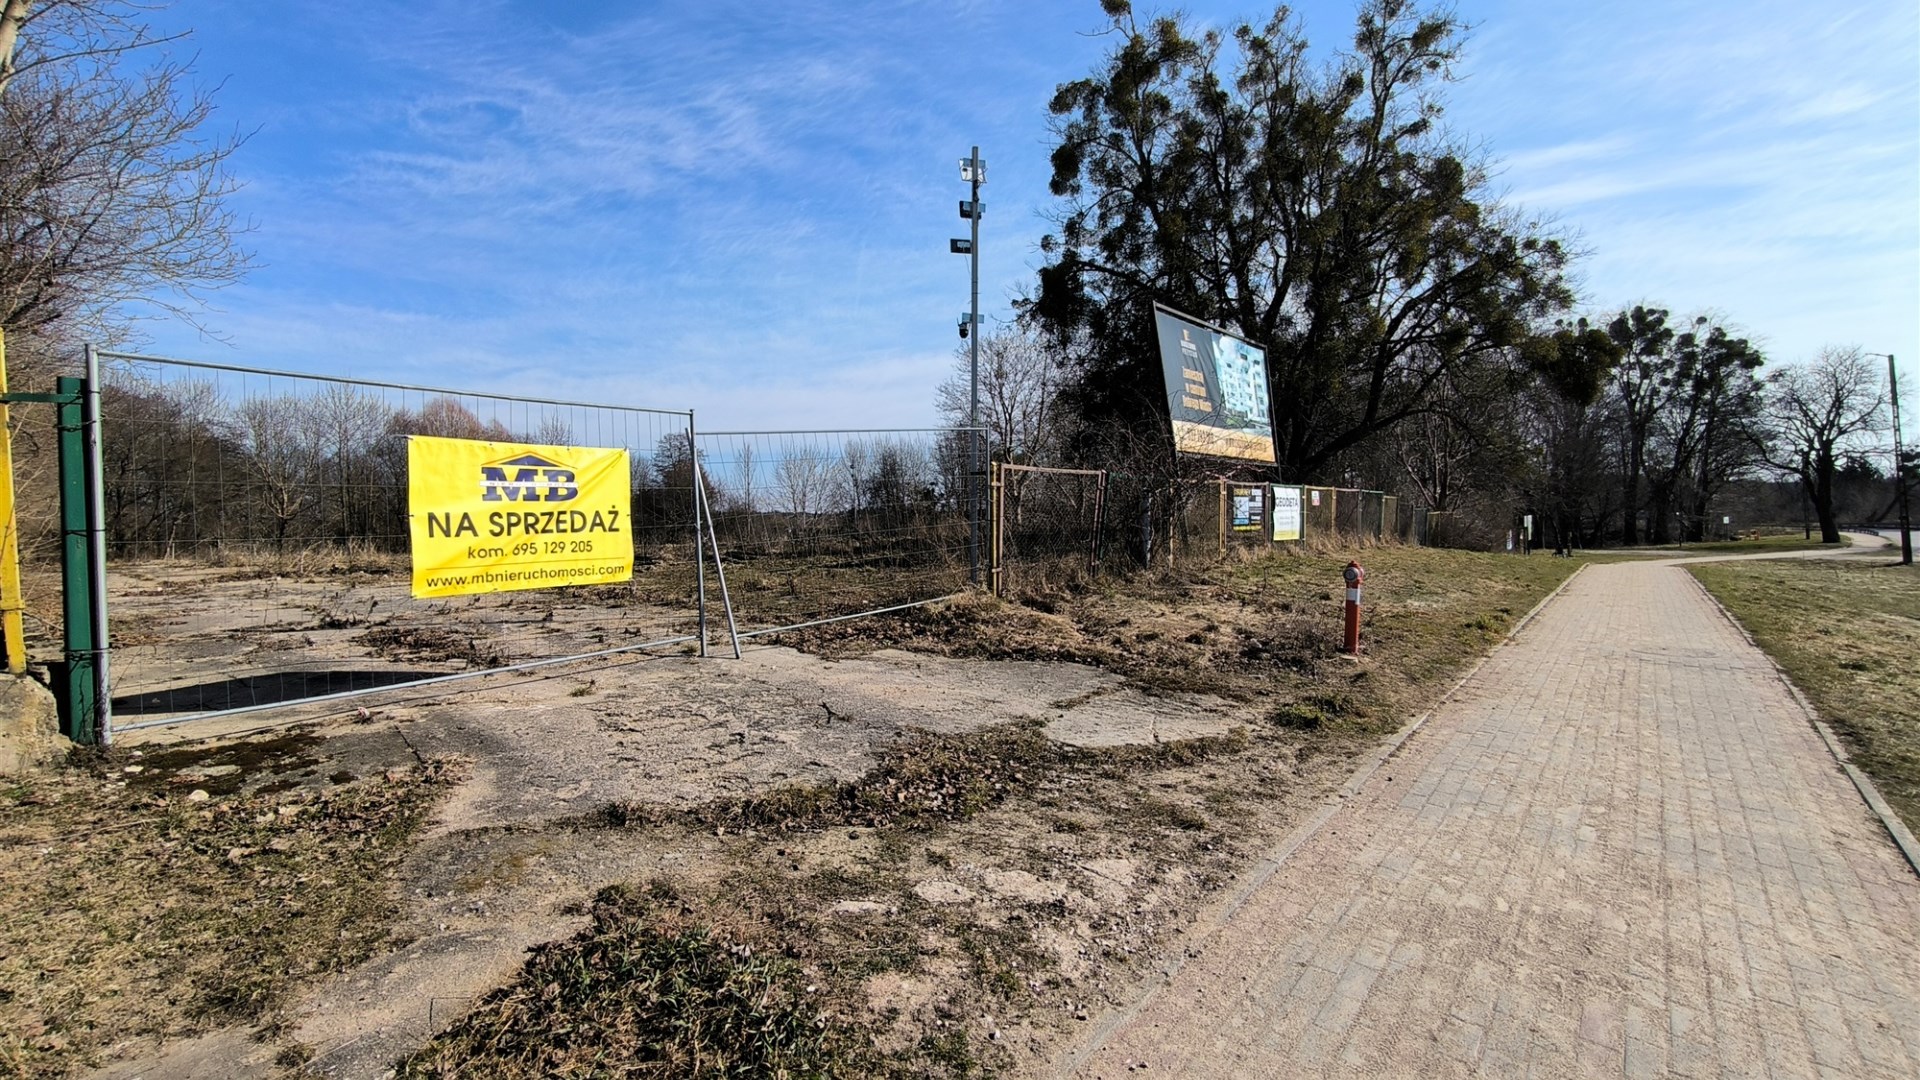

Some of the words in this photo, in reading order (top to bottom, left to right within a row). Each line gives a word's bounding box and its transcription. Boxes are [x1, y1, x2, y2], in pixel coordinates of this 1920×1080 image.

[481, 467, 578, 501] MB
[428, 512, 478, 538] NA
[489, 505, 620, 537] SPRZEDAŻ
[468, 546, 508, 558] kom.
[512, 542, 538, 556] 695
[544, 541, 566, 554] 129
[570, 540, 593, 553] 205
[426, 565, 625, 588] www.mbnieruchomosci.com
